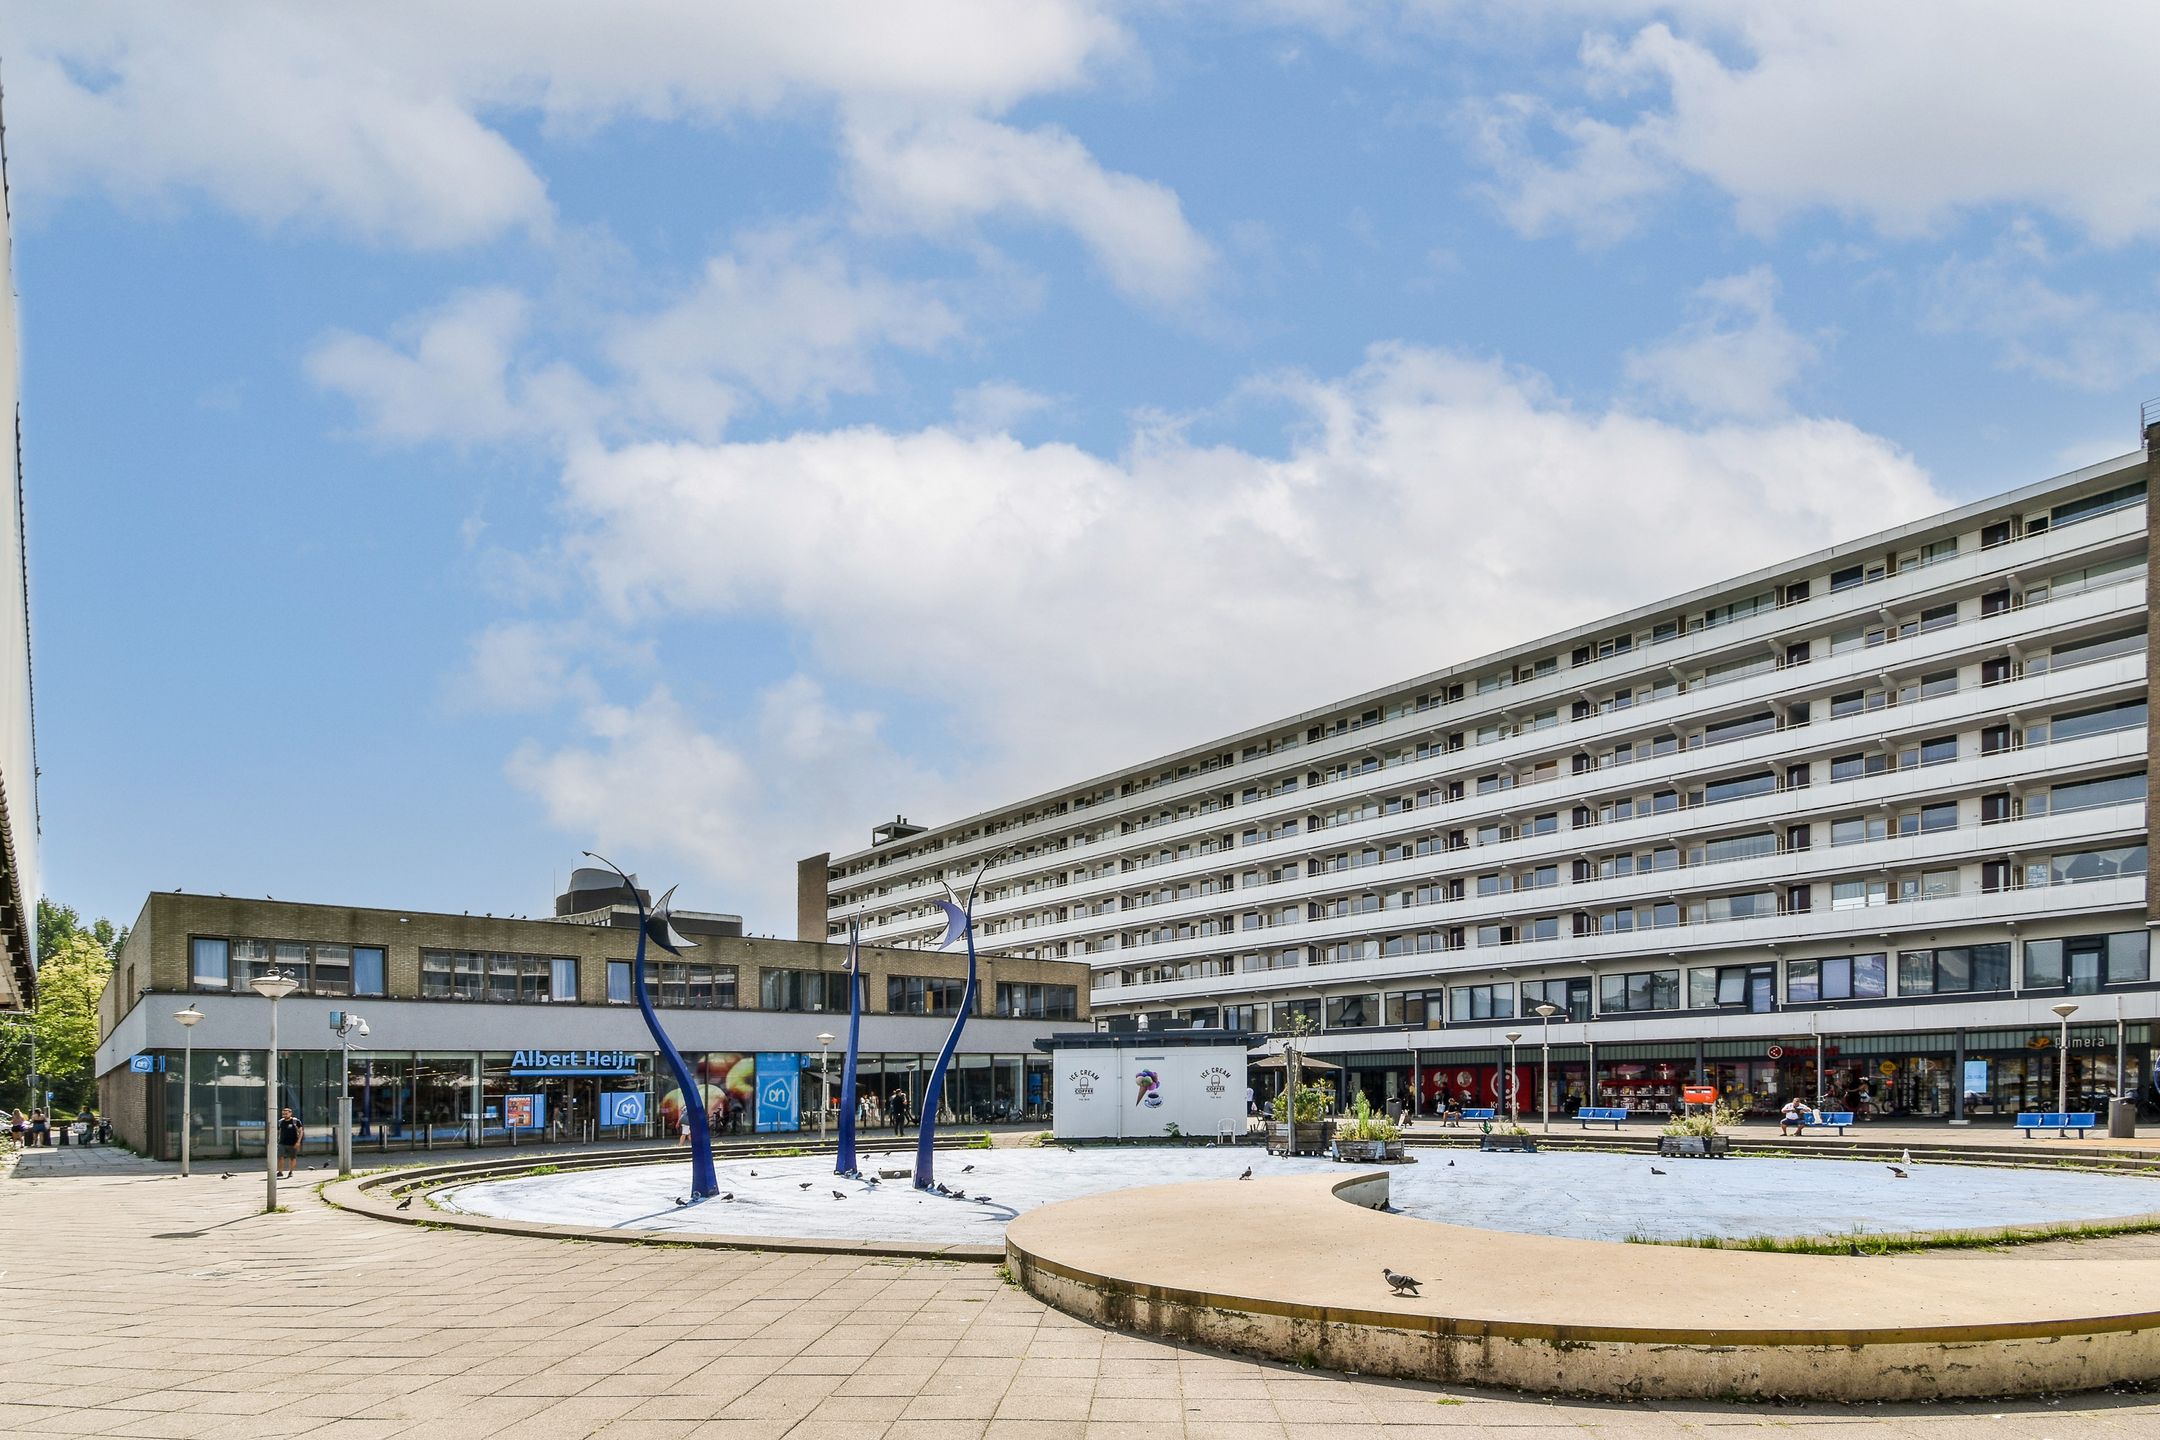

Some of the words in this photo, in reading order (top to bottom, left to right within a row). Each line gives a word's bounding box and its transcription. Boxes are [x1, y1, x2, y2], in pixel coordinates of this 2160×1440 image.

[2055, 1037, 2105, 1048] Pimera
[511, 1050, 579, 1067] Albert
[586, 1050, 636, 1070] Heijn
[1069, 1071, 1079, 1081] ICE
[1080, 1069, 1100, 1081] CREAM
[1200, 1070, 1211, 1079] ICE
[1211, 1067, 1232, 1079] CREAM
[1490, 1101, 1521, 1110] Krdvt
